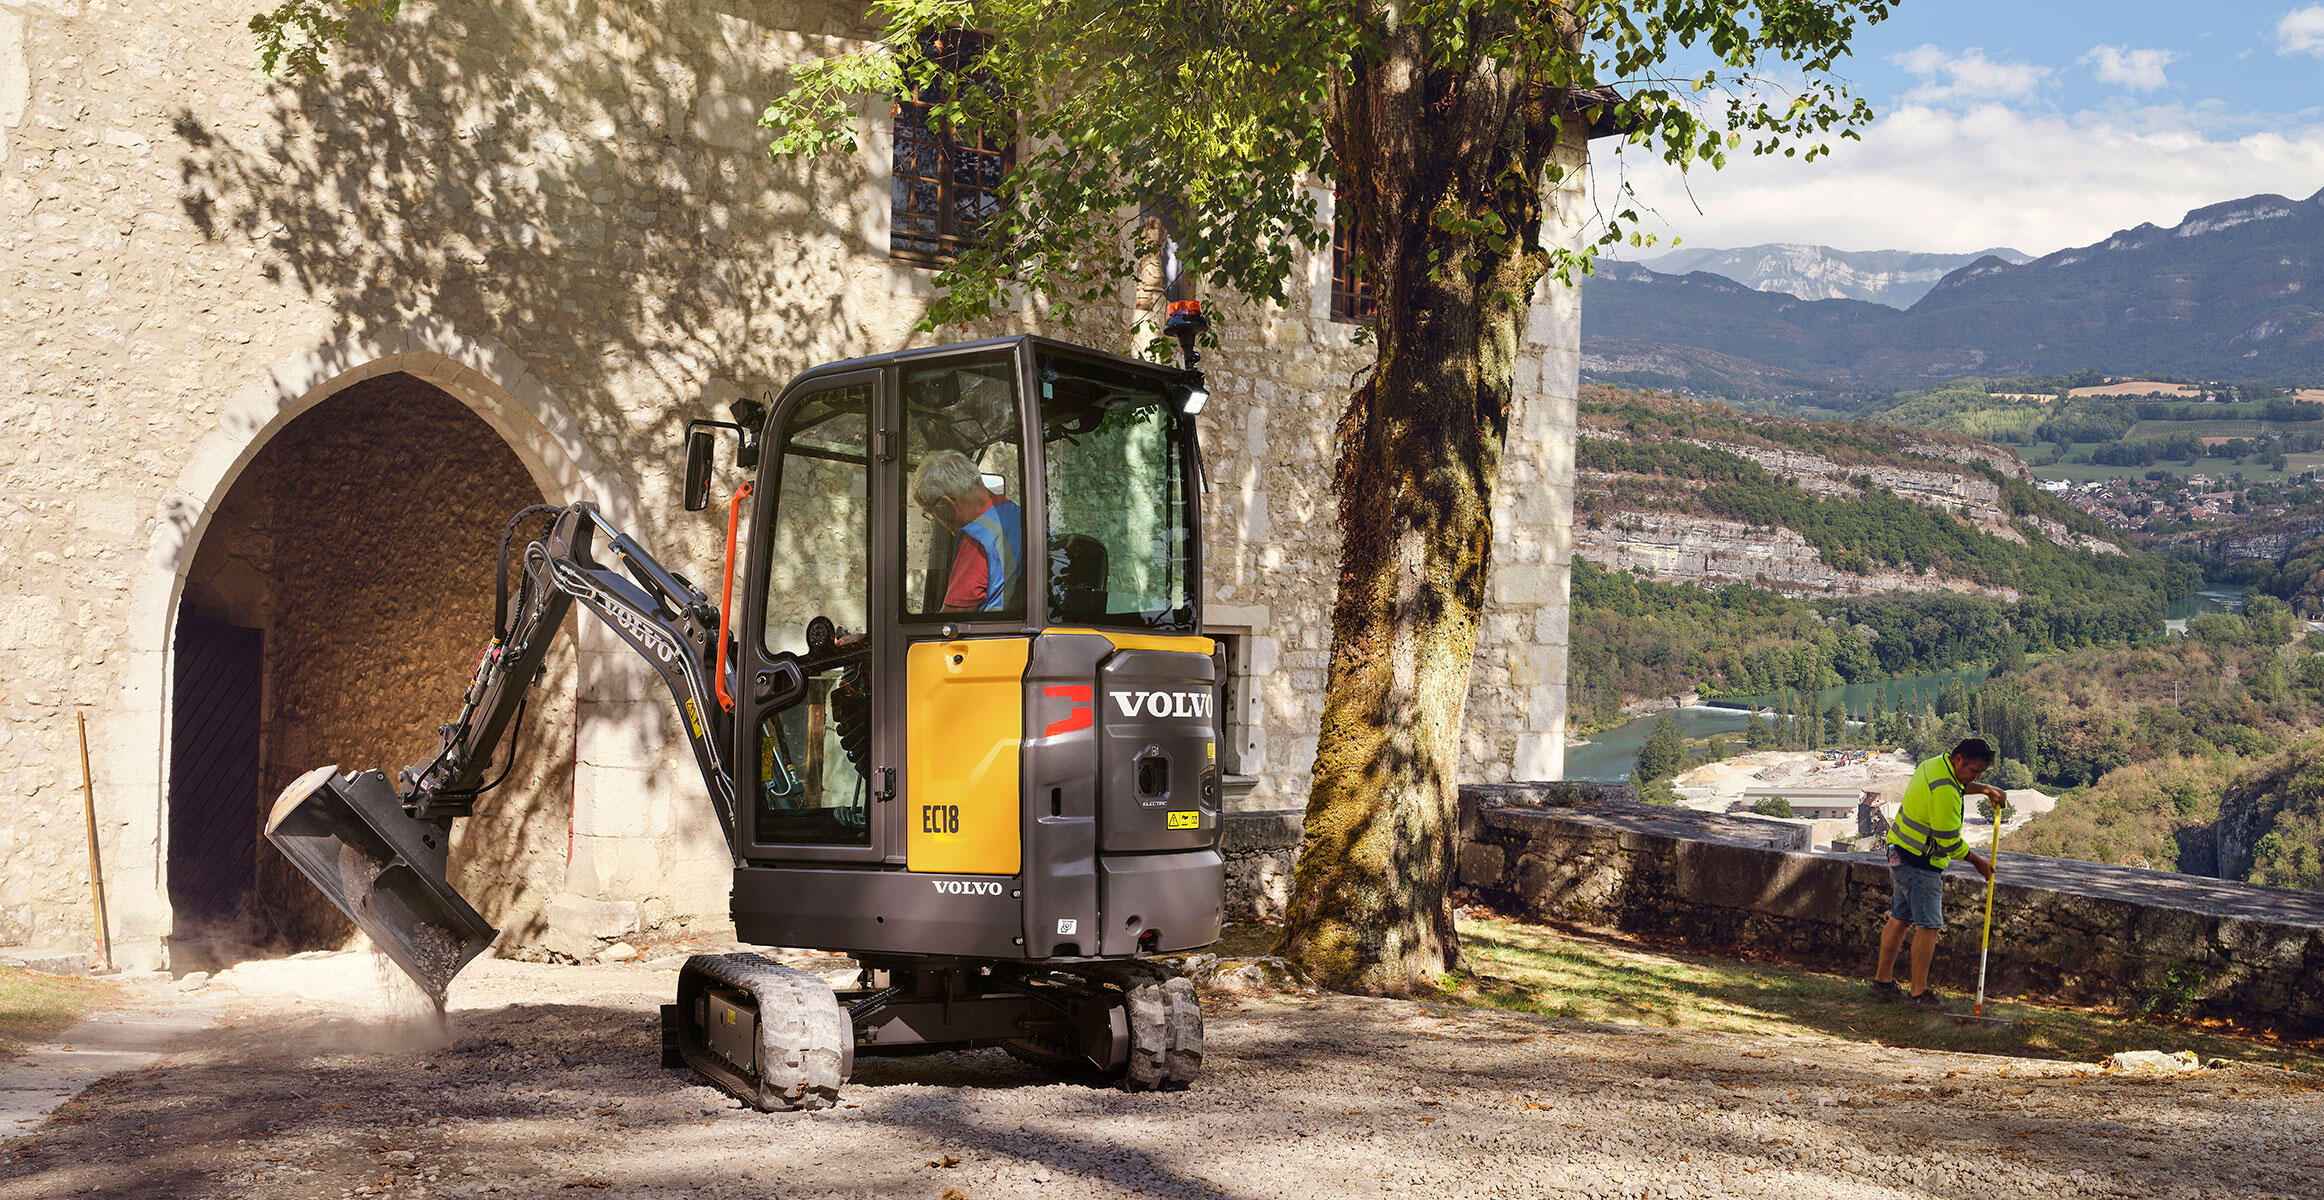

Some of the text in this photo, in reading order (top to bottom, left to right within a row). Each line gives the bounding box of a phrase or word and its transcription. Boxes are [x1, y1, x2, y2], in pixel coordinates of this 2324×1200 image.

[604, 599, 674, 663] VOLVO
[1109, 691, 1214, 719] VOLVO
[922, 804, 960, 834] EC18
[932, 880, 1003, 896] VOLVO
